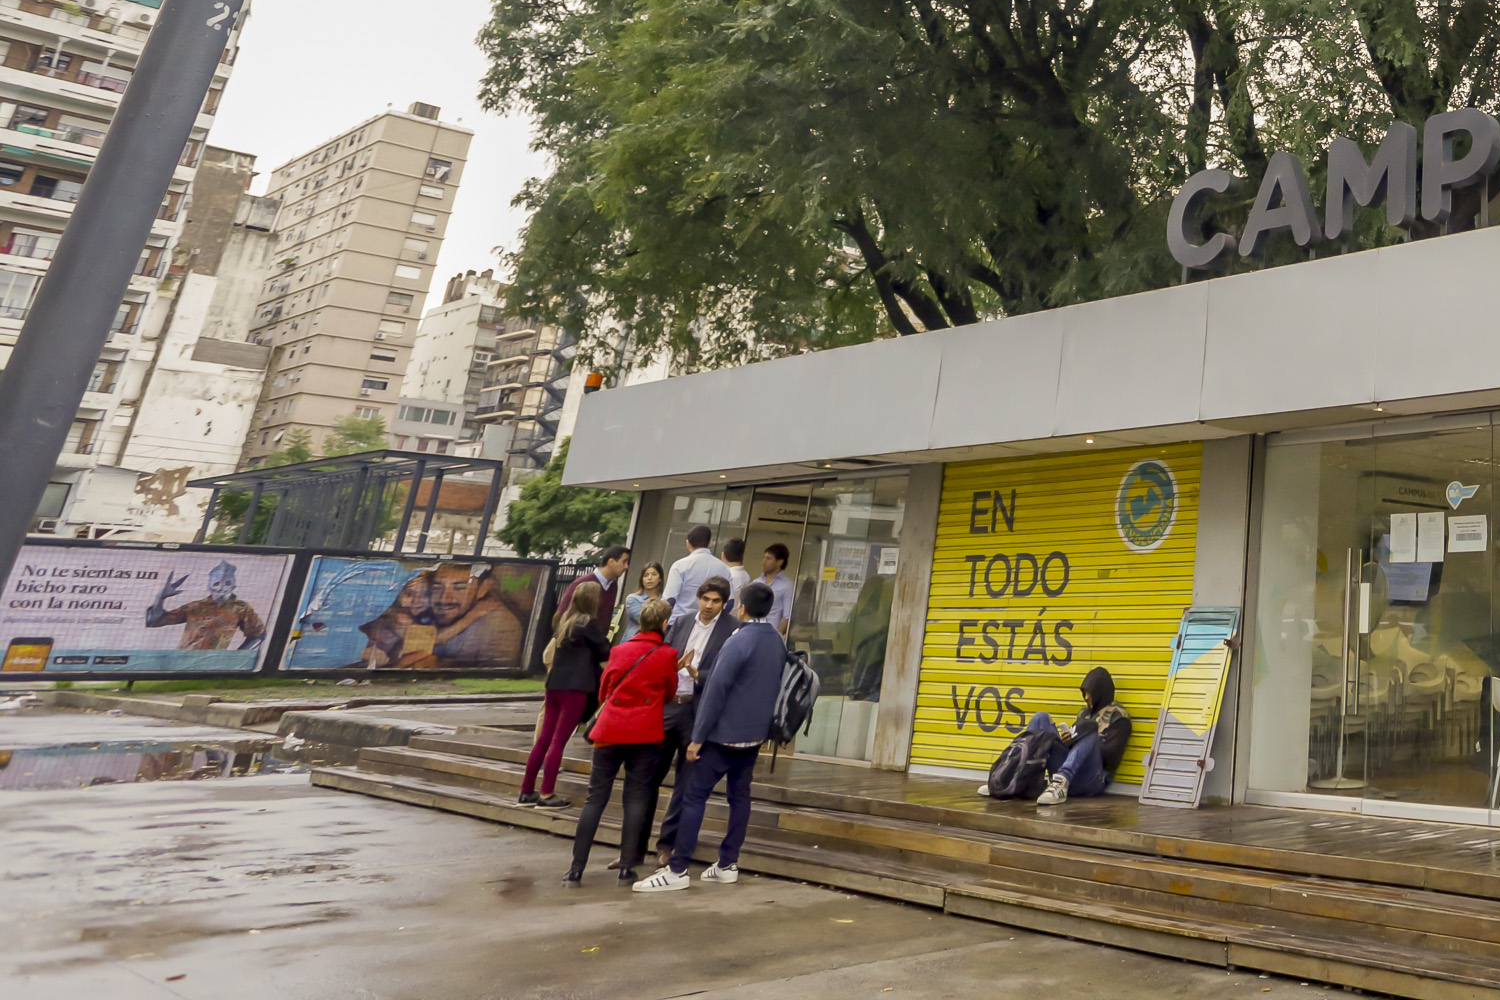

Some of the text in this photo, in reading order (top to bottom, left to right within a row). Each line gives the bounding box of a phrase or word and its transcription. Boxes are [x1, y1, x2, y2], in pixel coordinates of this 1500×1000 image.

[205, 2, 240, 37] 2
[969, 488, 1017, 535] EN
[15, 580, 108, 595] bicho raro
[21, 565, 159, 580] No te sientas un
[964, 551, 1070, 598] TODO
[9, 596, 128, 610] con la nonna.
[955, 608, 1074, 667] ESTÁS
[951, 685, 1027, 734] VOS
